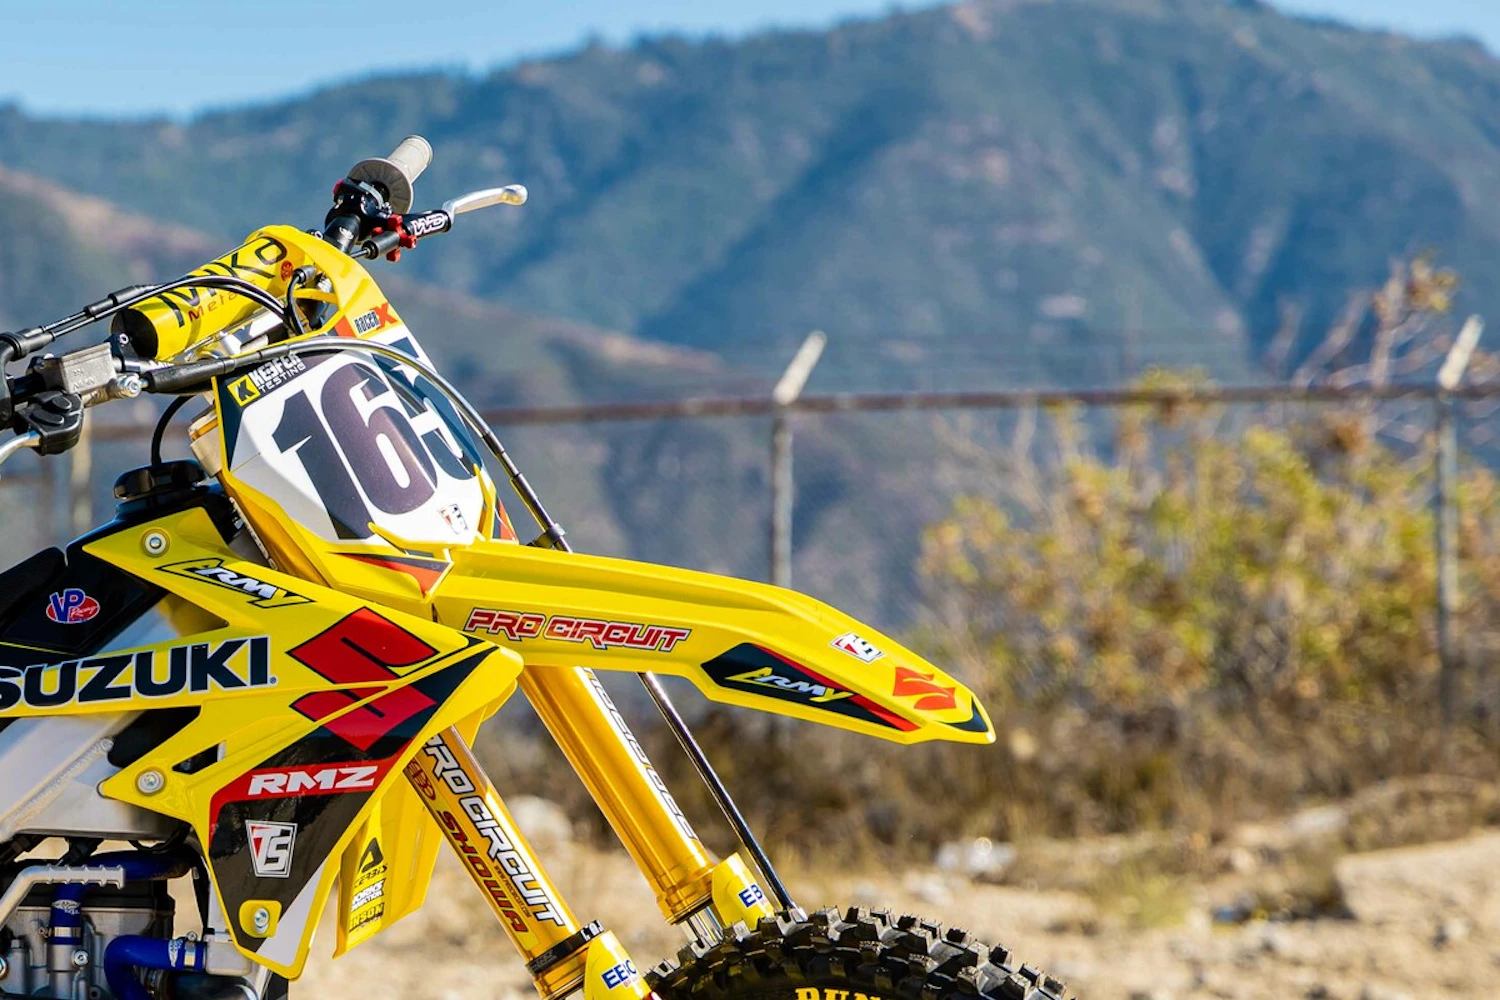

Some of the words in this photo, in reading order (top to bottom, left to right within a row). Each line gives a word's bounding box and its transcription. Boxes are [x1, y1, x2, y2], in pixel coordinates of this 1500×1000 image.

[258, 362, 306, 393] TESTING
[272, 336, 483, 540] 165
[49, 588, 85, 623] VP
[465, 608, 545, 641] PRO
[544, 616, 692, 652] CIRCUIT
[248, 766, 378, 796] RMZ
[437, 811, 528, 932] SHOWA
[459, 796, 565, 926] CIRCUIT
[739, 885, 763, 908] EB
